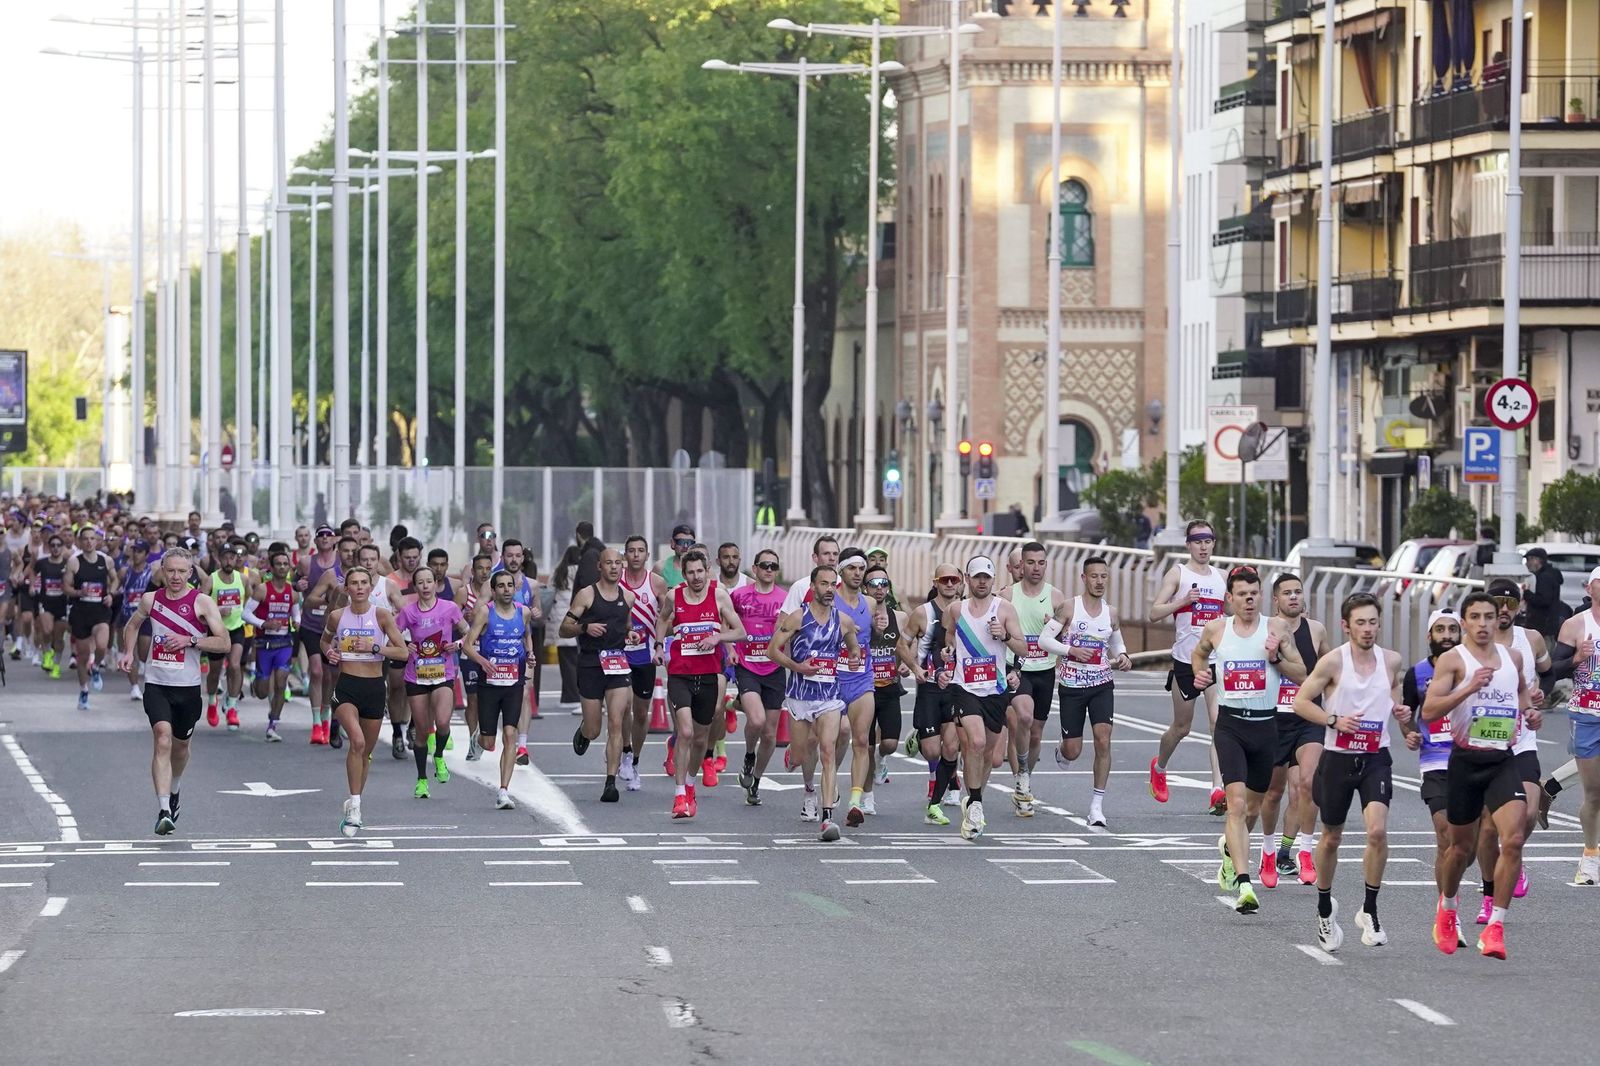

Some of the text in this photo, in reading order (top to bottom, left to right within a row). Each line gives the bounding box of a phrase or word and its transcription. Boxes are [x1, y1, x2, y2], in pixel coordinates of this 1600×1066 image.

[1469, 432, 1492, 462] P
[158, 653, 177, 661] MARK
[973, 673, 988, 682] DAN
[1234, 681, 1255, 690] LOLA
[1488, 708, 1513, 717] ZURICH
[1359, 721, 1379, 729] URICH
[1480, 728, 1508, 739] KATEB
[1348, 740, 1369, 751] MAX
